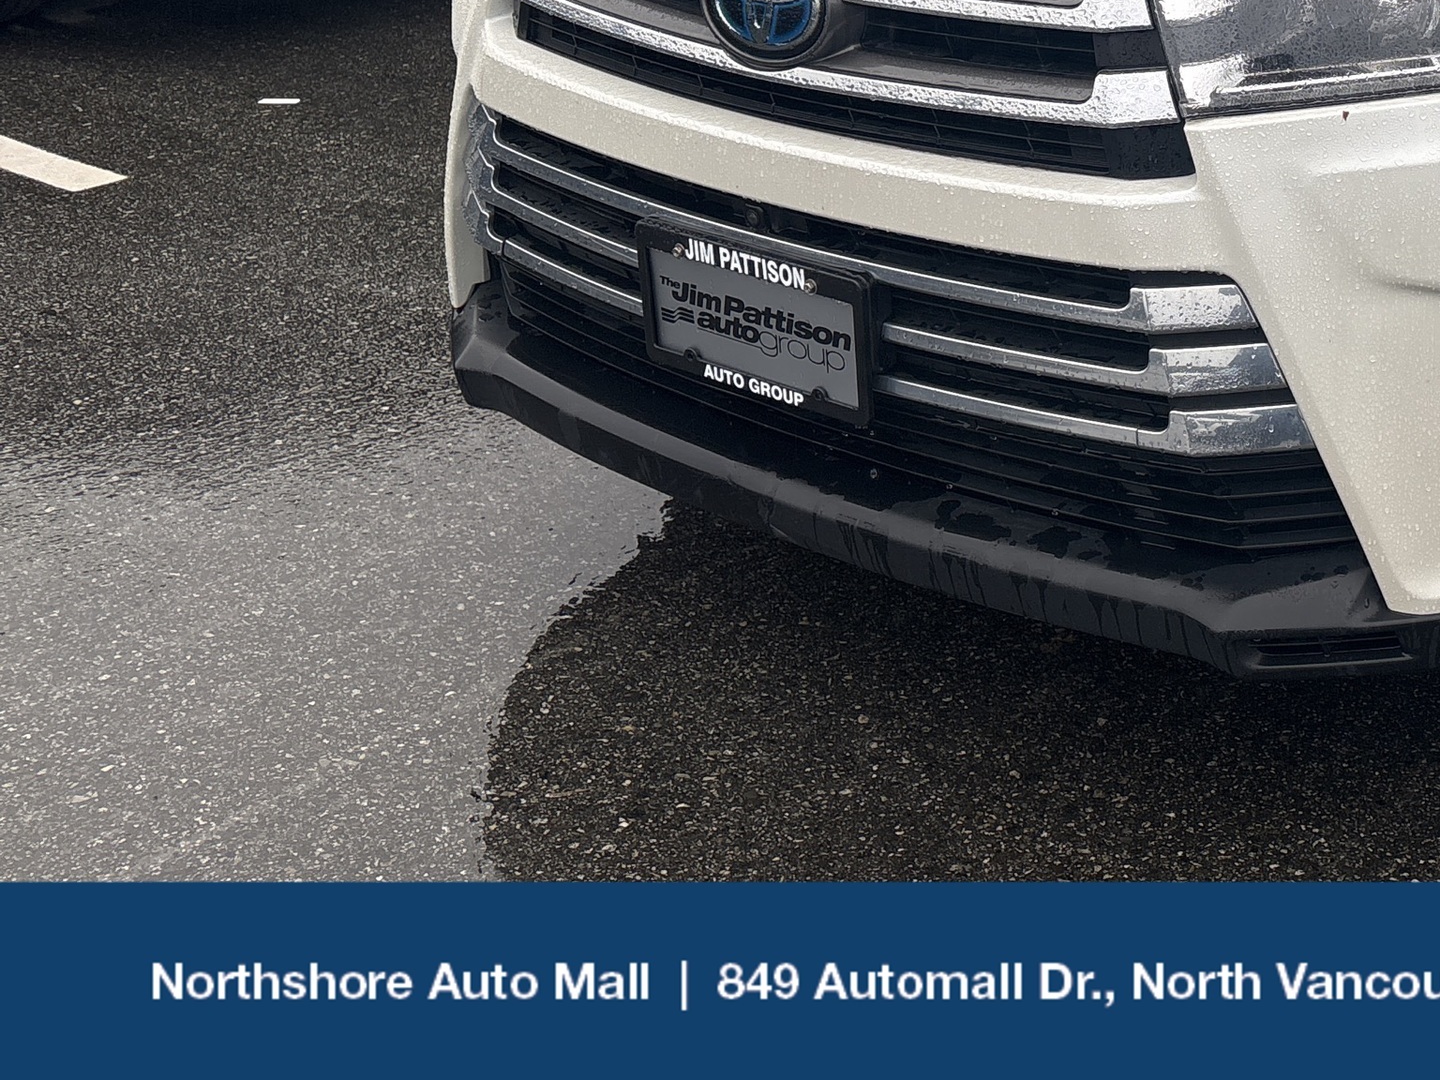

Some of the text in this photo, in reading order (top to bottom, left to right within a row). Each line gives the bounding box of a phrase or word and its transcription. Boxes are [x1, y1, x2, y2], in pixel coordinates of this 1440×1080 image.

[659, 274, 681, 290] The
[684, 237, 807, 291] JIM PATTISON
[671, 282, 851, 352] Jim Pattison
[703, 363, 805, 407] AUTO GROUP
